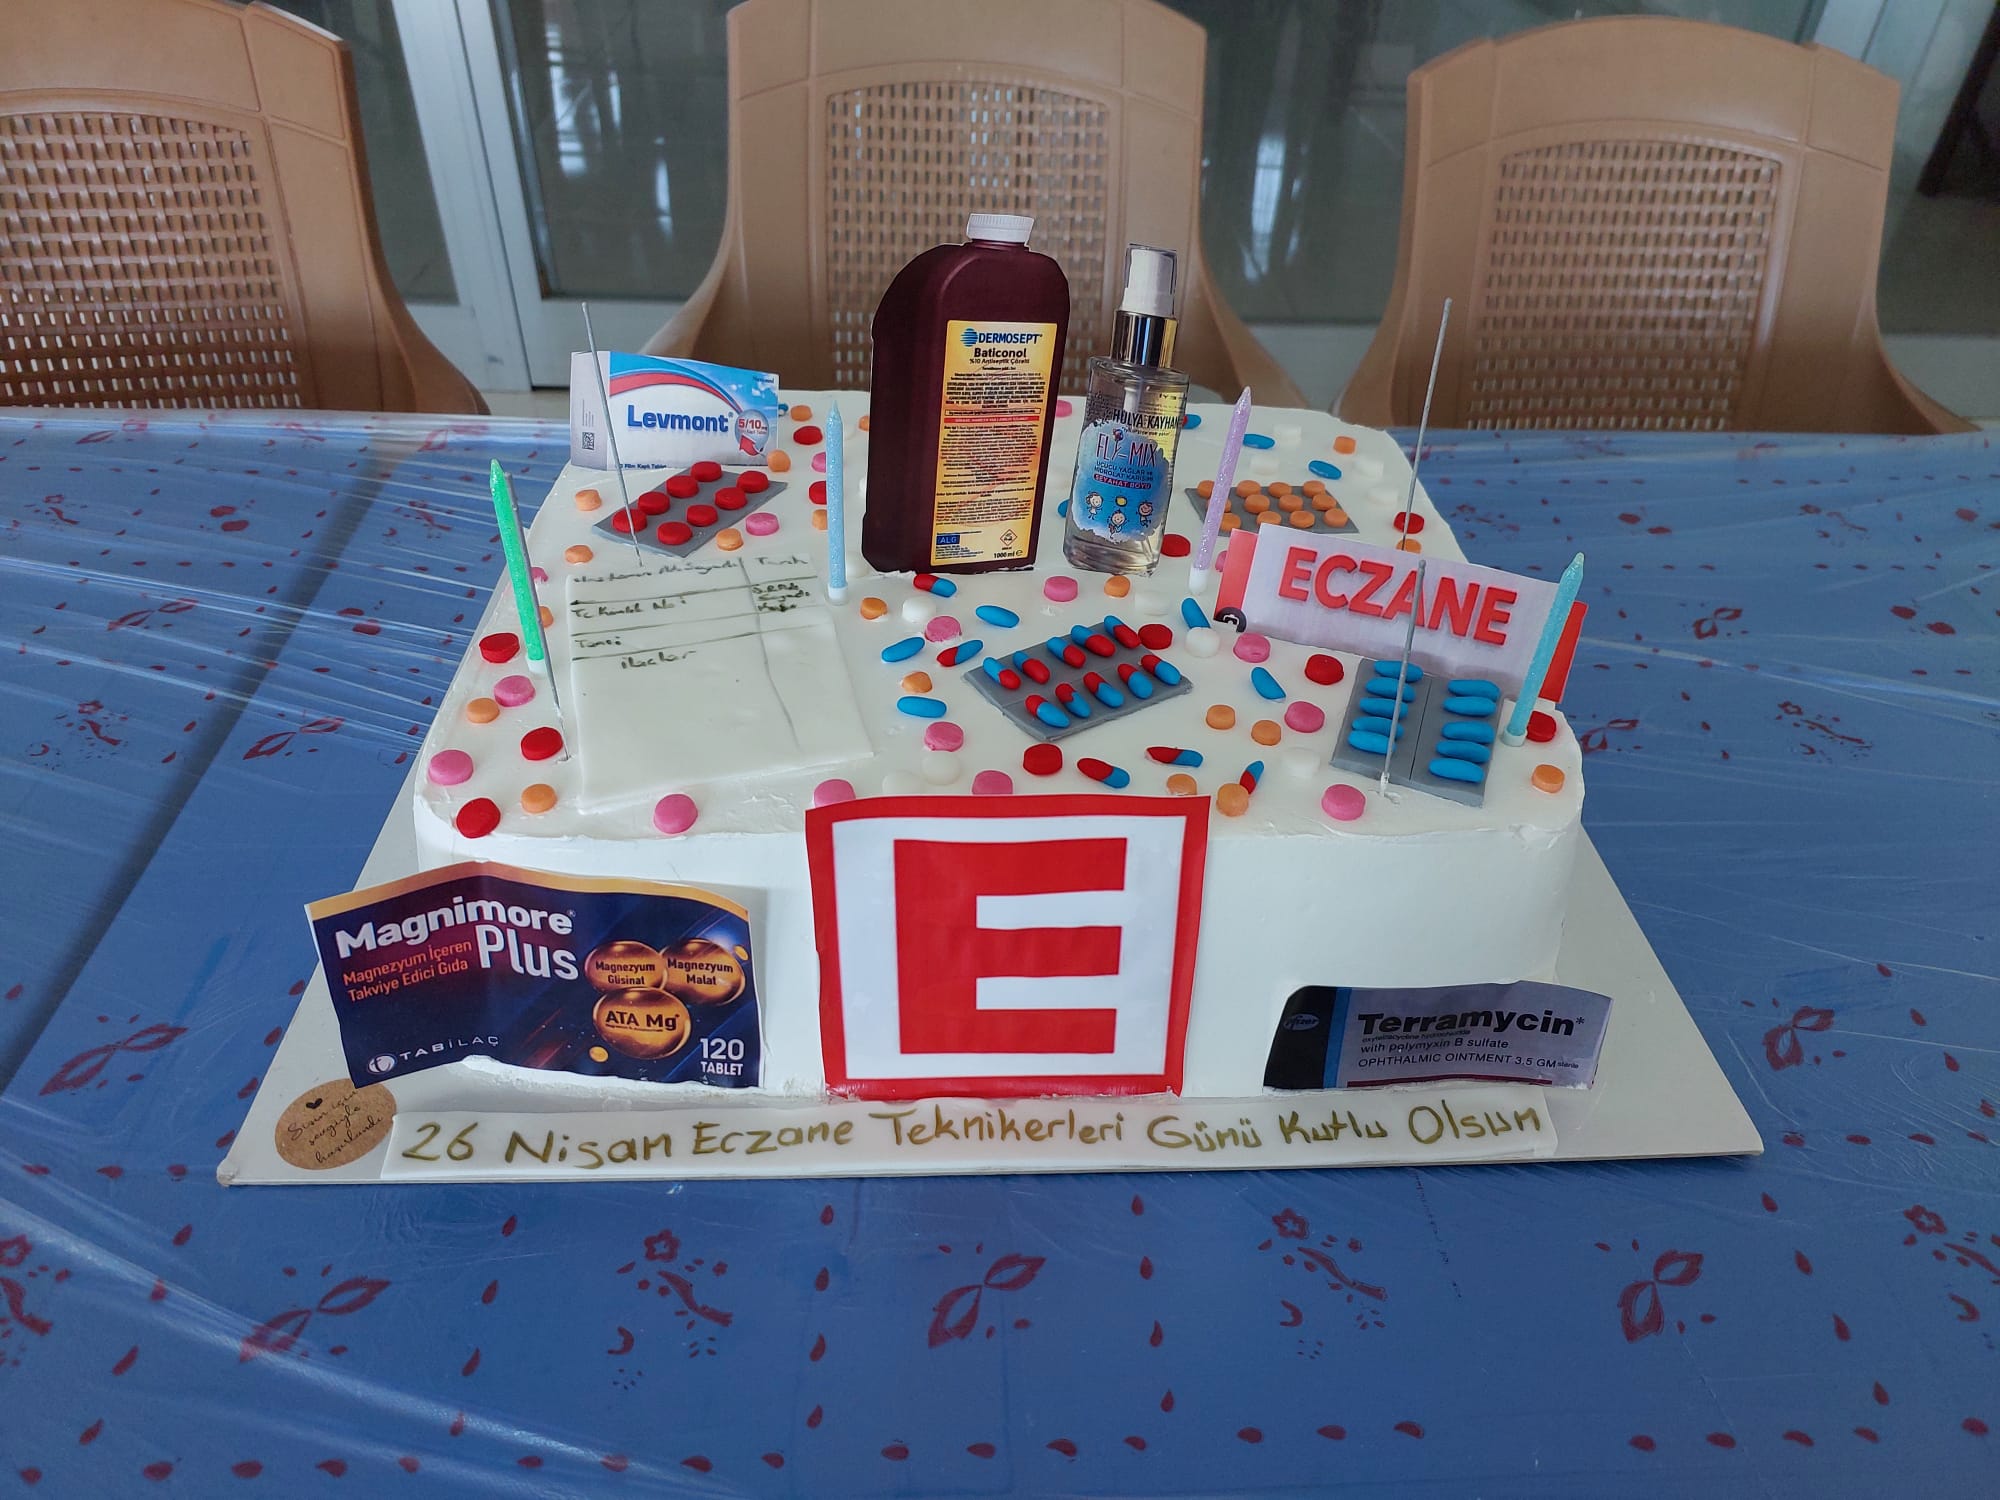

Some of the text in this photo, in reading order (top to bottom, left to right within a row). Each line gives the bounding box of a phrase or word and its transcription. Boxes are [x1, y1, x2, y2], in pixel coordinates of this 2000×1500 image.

[978, 333, 1040, 345] DERMOSEPT
[974, 347, 1027, 358] Baticonol
[627, 404, 729, 432] Levmont
[738, 418, 762, 430] 5/10
[1277, 545, 1518, 646] ECZANE
[335, 895, 574, 959] Magnimore
[475, 924, 580, 981] Plus
[893, 837, 1128, 1055] E
[343, 941, 472, 987] Magnezyum İçeren
[595, 960, 656, 974] Magnezyum
[667, 957, 734, 974] Magnezyum
[348, 958, 469, 1001] Takviye Edici Gıda
[686, 973, 717, 986] Malat
[605, 1010, 640, 1027] ATA
[1357, 1009, 1575, 1036] Terramycin
[399, 1036, 499, 1061] TABİLAÇ
[699, 1038, 745, 1061] 120
[1361, 1043, 1385, 1053] with
[1389, 1039, 1450, 1053] polymyxin
[1454, 1037, 1463, 1046] B
[700, 1062, 744, 1076] TABLET
[1358, 1053, 1441, 1068] OPHTHALMIC
[1444, 1052, 1513, 1065] OINTMENT
[1514, 1056, 1533, 1066] 3.5
[1536, 1058, 1557, 1068] GM
[401, 1121, 480, 1162] 26
[692, 1120, 854, 1155] Eczane
[868, 1103, 1125, 1146] Teknikerleri
[1146, 1114, 1262, 1152] Günü
[1278, 1109, 1388, 1145] Kutlu
[1407, 1099, 1541, 1145] Olsun
